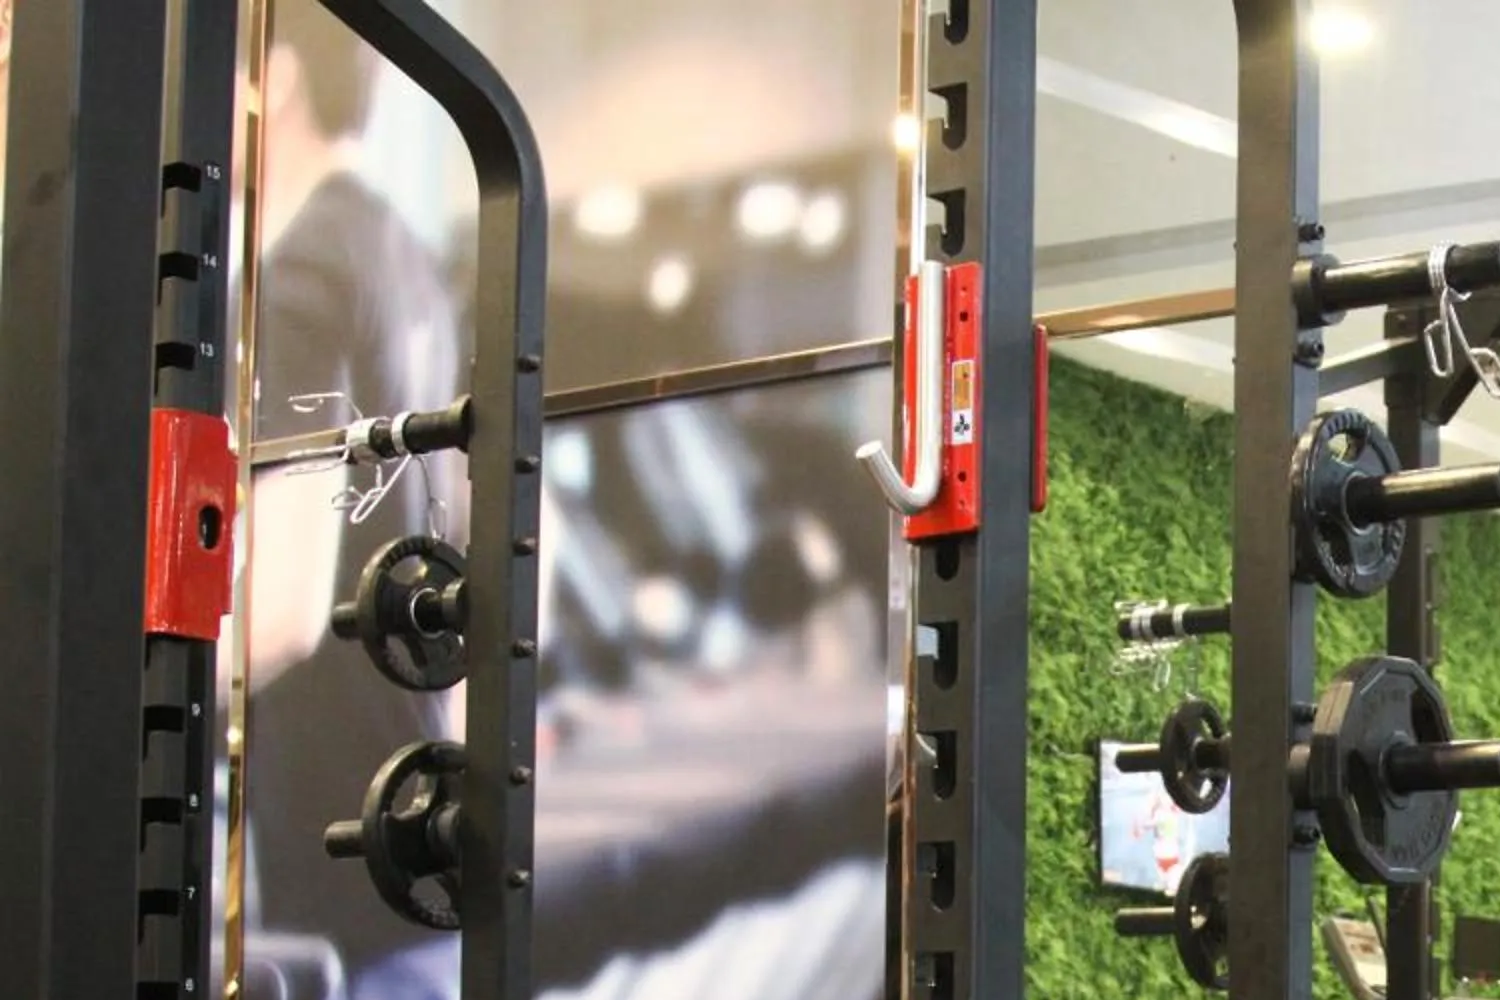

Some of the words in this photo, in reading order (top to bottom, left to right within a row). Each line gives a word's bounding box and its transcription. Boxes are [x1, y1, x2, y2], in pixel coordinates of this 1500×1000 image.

[207, 165, 221, 179] 15
[203, 254, 218, 268] 14
[200, 342, 214, 357] 13
[186, 886, 196, 899] 7
